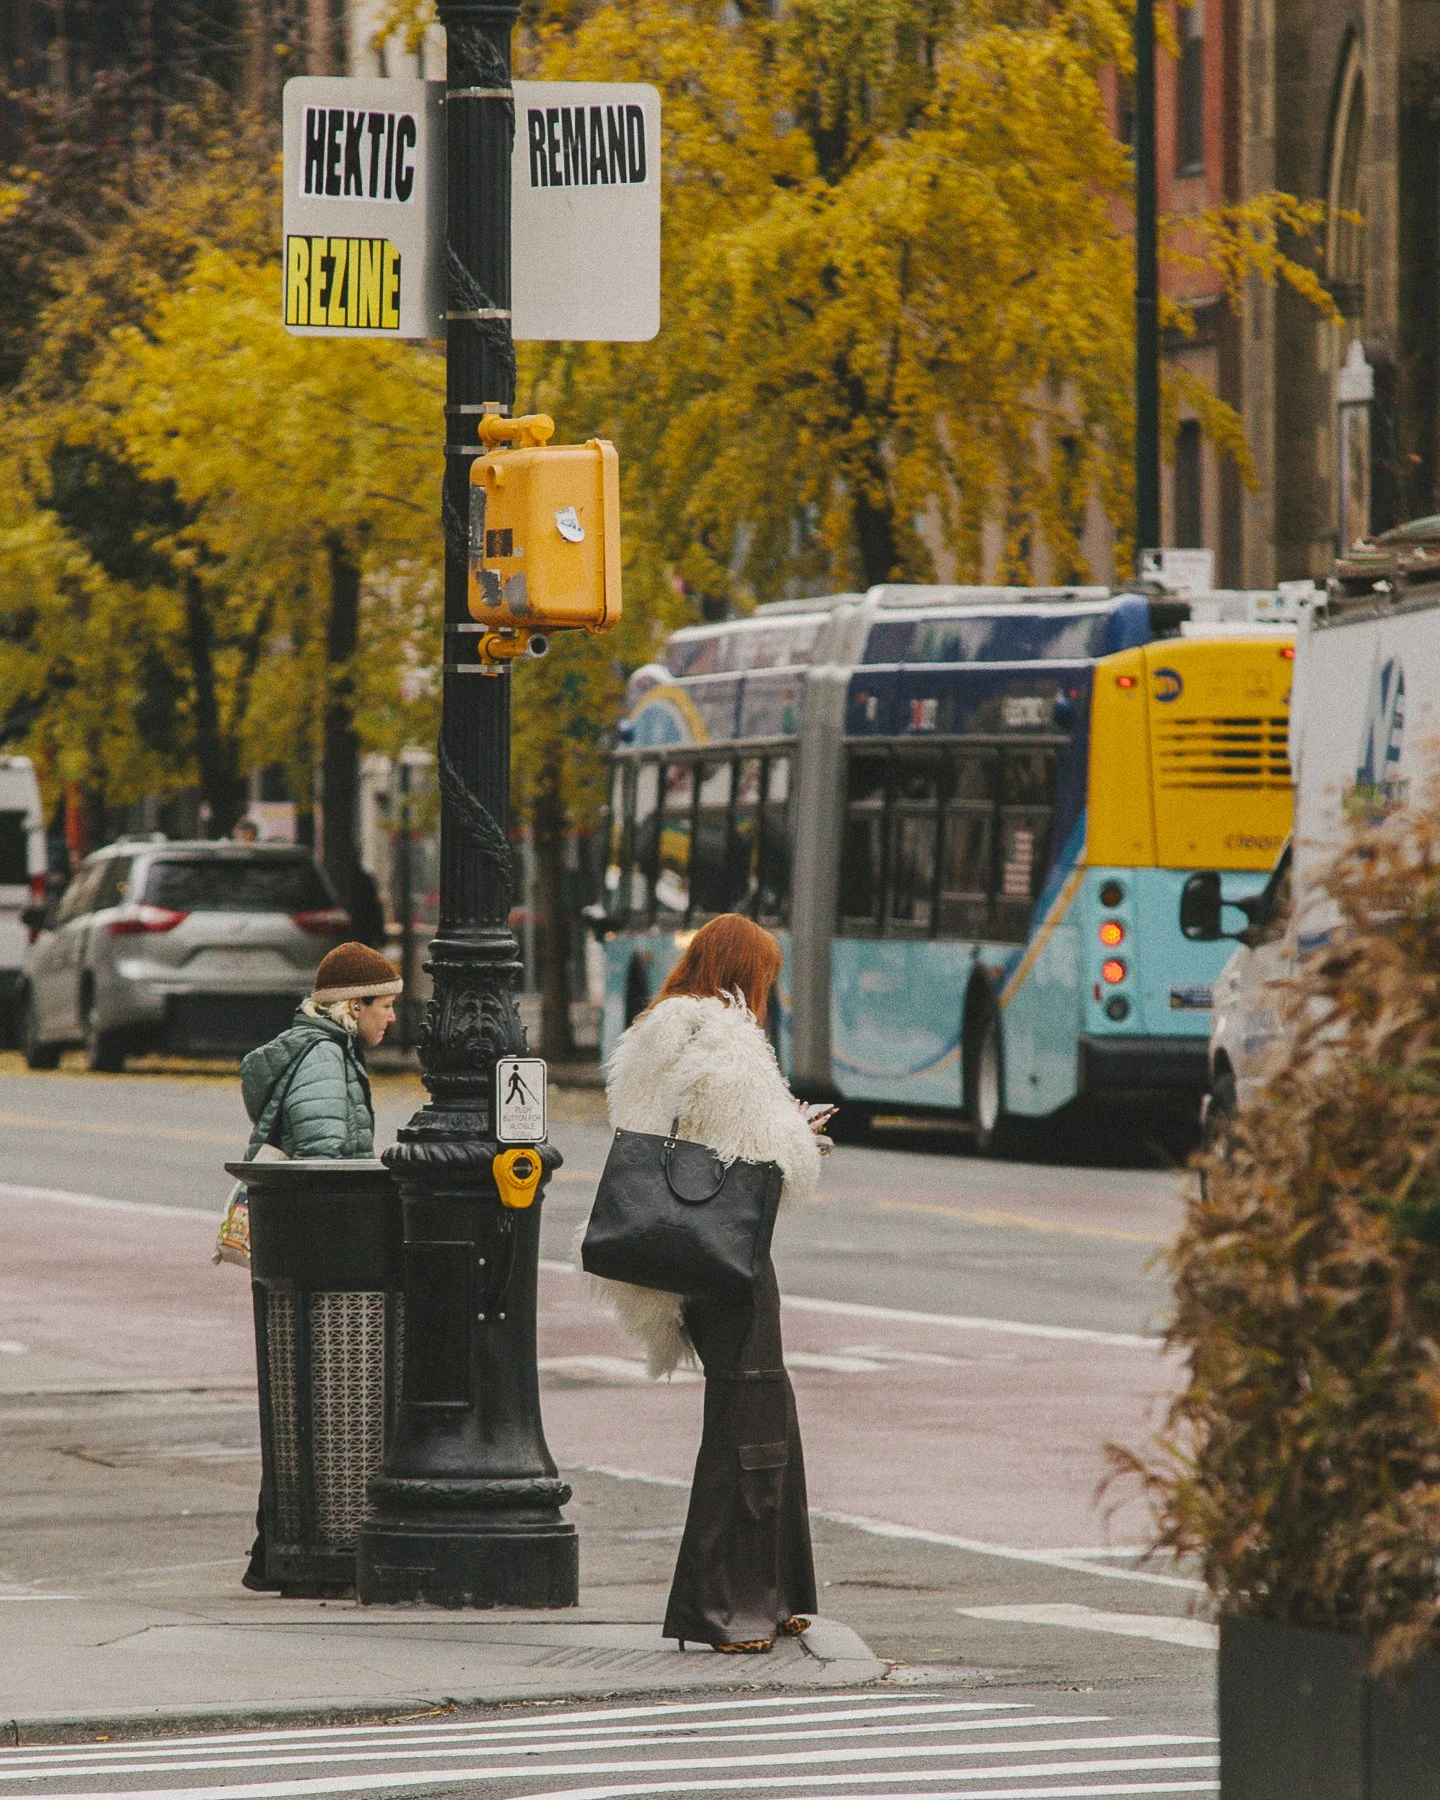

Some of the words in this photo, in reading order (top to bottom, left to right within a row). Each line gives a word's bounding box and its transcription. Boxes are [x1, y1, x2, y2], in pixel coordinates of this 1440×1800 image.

[303, 108, 417, 203] HEKTIC
[527, 105, 647, 188] REMAND
[286, 235, 400, 330] REZINE
[502, 1114, 527, 1122] BUTTON
[528, 1114, 541, 1122] FOR
[514, 1106, 532, 1114] PUSH
